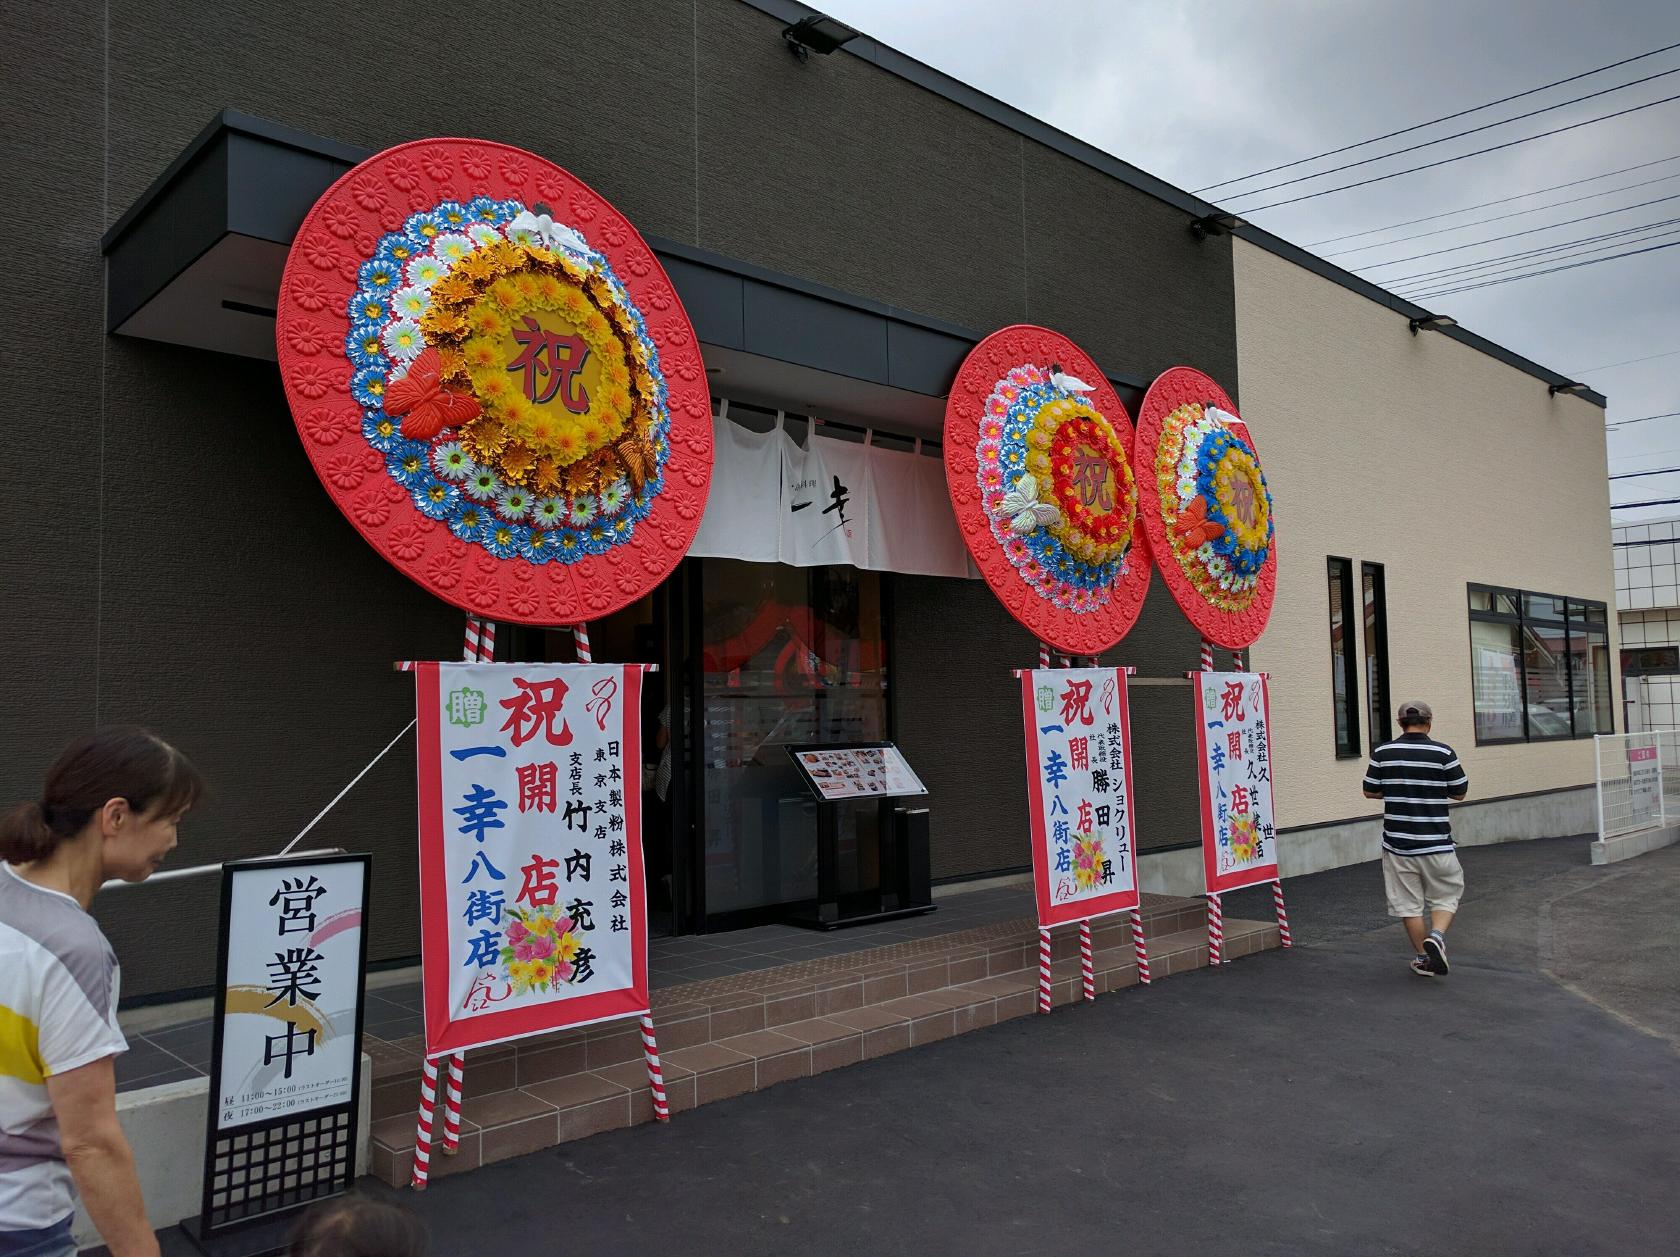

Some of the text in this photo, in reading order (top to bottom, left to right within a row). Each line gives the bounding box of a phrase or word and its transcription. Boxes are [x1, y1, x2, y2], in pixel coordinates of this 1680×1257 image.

[506, 315, 591, 414] 祝
[1073, 448, 1112, 511] 祝
[1230, 475, 1255, 529] 祝
[449, 690, 485, 726] 贈
[593, 748, 608, 840] 東京支店
[1040, 724, 1072, 873] 一幸八街店
[1207, 720, 1229, 848] 一幸八街店
[449, 745, 508, 969] 一幸八街店
[607, 739, 629, 933] 日本製粉株式会社
[264, 875, 327, 1080] 営業中
[223, 1110, 234, 1122] 夜
